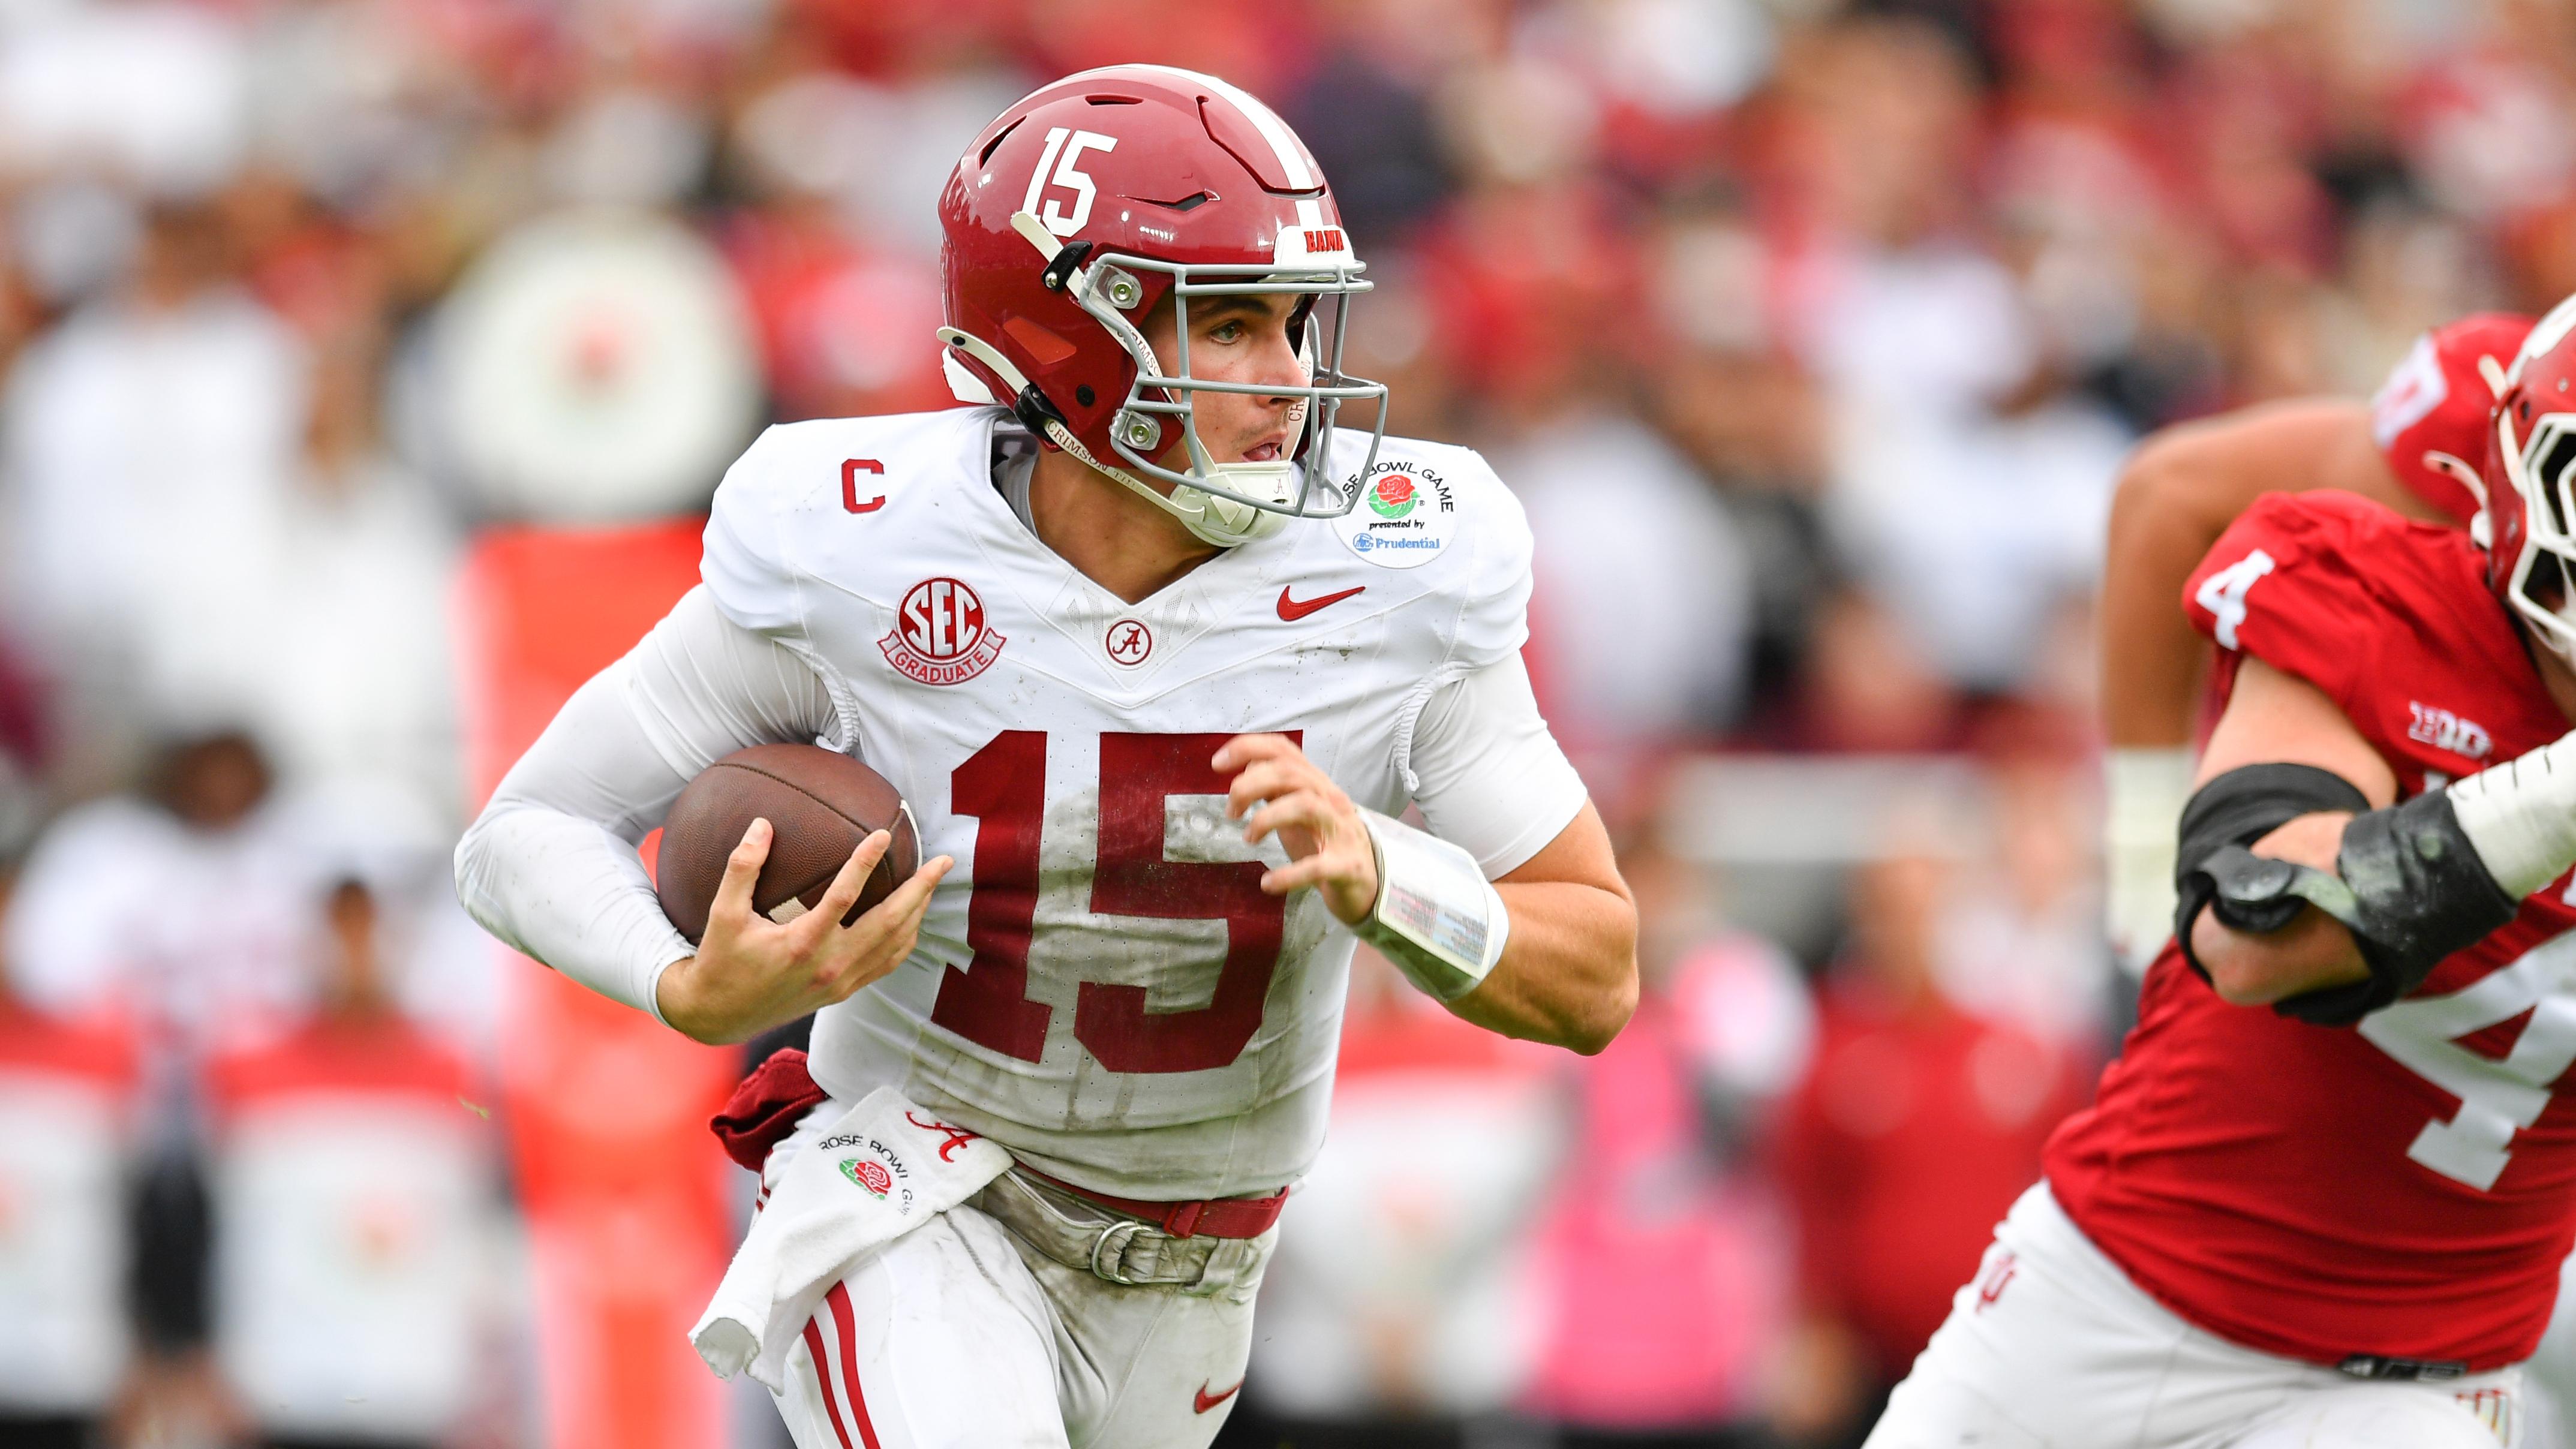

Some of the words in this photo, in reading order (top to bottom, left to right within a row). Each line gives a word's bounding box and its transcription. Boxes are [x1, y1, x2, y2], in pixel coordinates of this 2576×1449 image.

[1021, 127, 1119, 238] 15
[1303, 230, 1345, 253] BAMA
[1048, 421, 1108, 471] CRIMSON
[841, 458, 885, 514] C
[1421, 468, 1454, 513] GAME
[1369, 519, 1411, 531] presented
[1414, 519, 1424, 529] by
[1376, 537, 1440, 549] Prudential
[903, 581, 978, 657] SEC
[2196, 548, 2275, 651] 4
[895, 651, 988, 683] GRADUATE
[930, 729, 1303, 1074] 15
[2356, 927, 2576, 1193] 4
